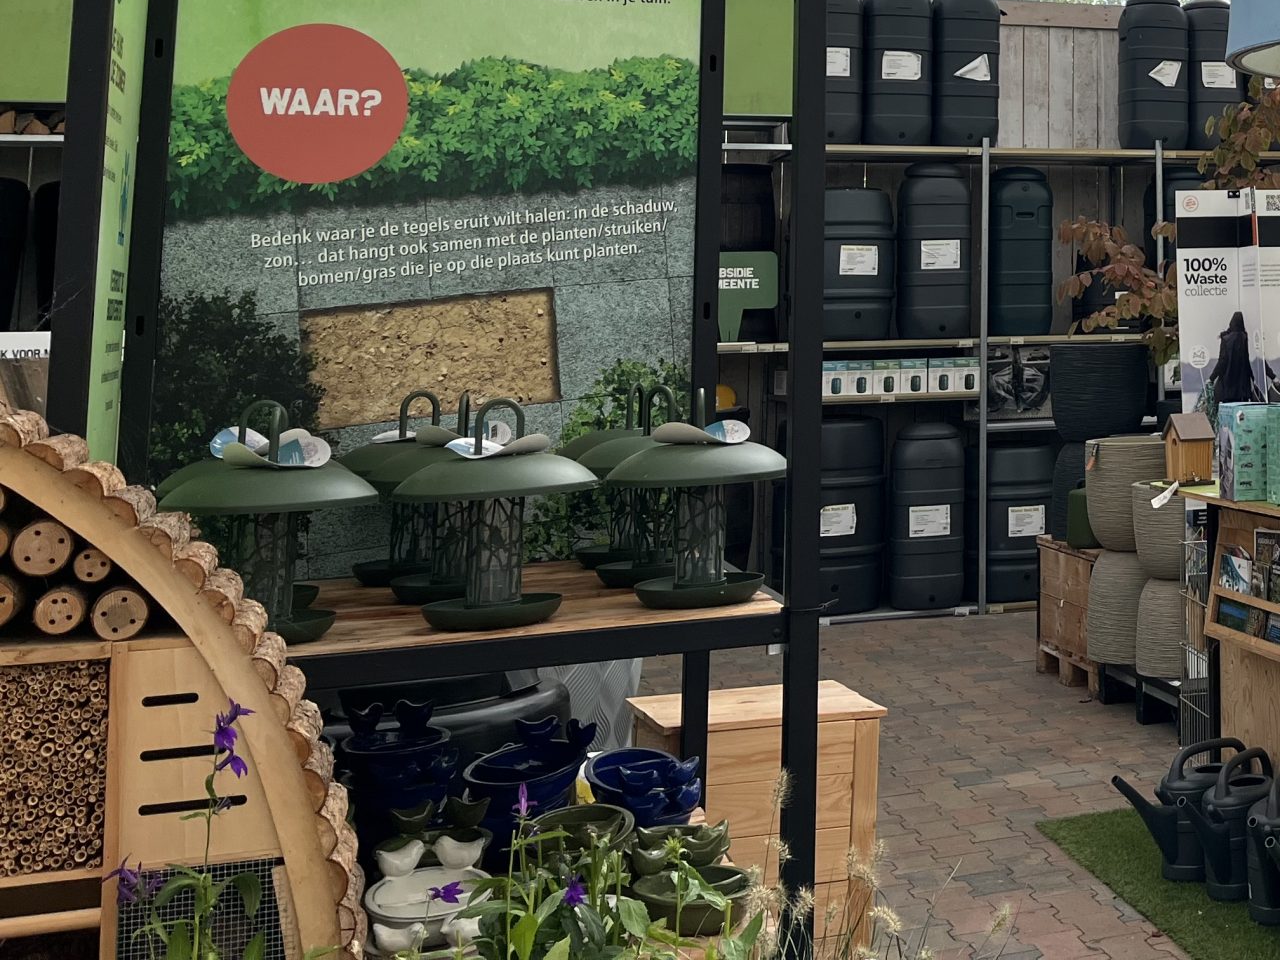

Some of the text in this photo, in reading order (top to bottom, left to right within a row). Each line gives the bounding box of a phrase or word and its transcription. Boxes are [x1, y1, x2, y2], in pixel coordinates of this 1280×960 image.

[260, 87, 382, 116] WAAR?
[251, 198, 678, 248] Bedenk waar je de tegels eruit wilt halen: in de schaduw,
[317, 247, 345, 263] dat
[349, 243, 395, 262] hangt
[399, 239, 428, 255] ook
[432, 236, 482, 253] samen
[486, 233, 516, 248] met
[519, 230, 537, 244] de
[542, 217, 668, 245] planten/struiken/
[298, 243, 642, 286] bomen/gras die je op die plaats kunt planten.
[1183, 257, 1228, 272] 100%
[1184, 273, 1228, 285] Waste
[1184, 284, 1228, 297] collectie
